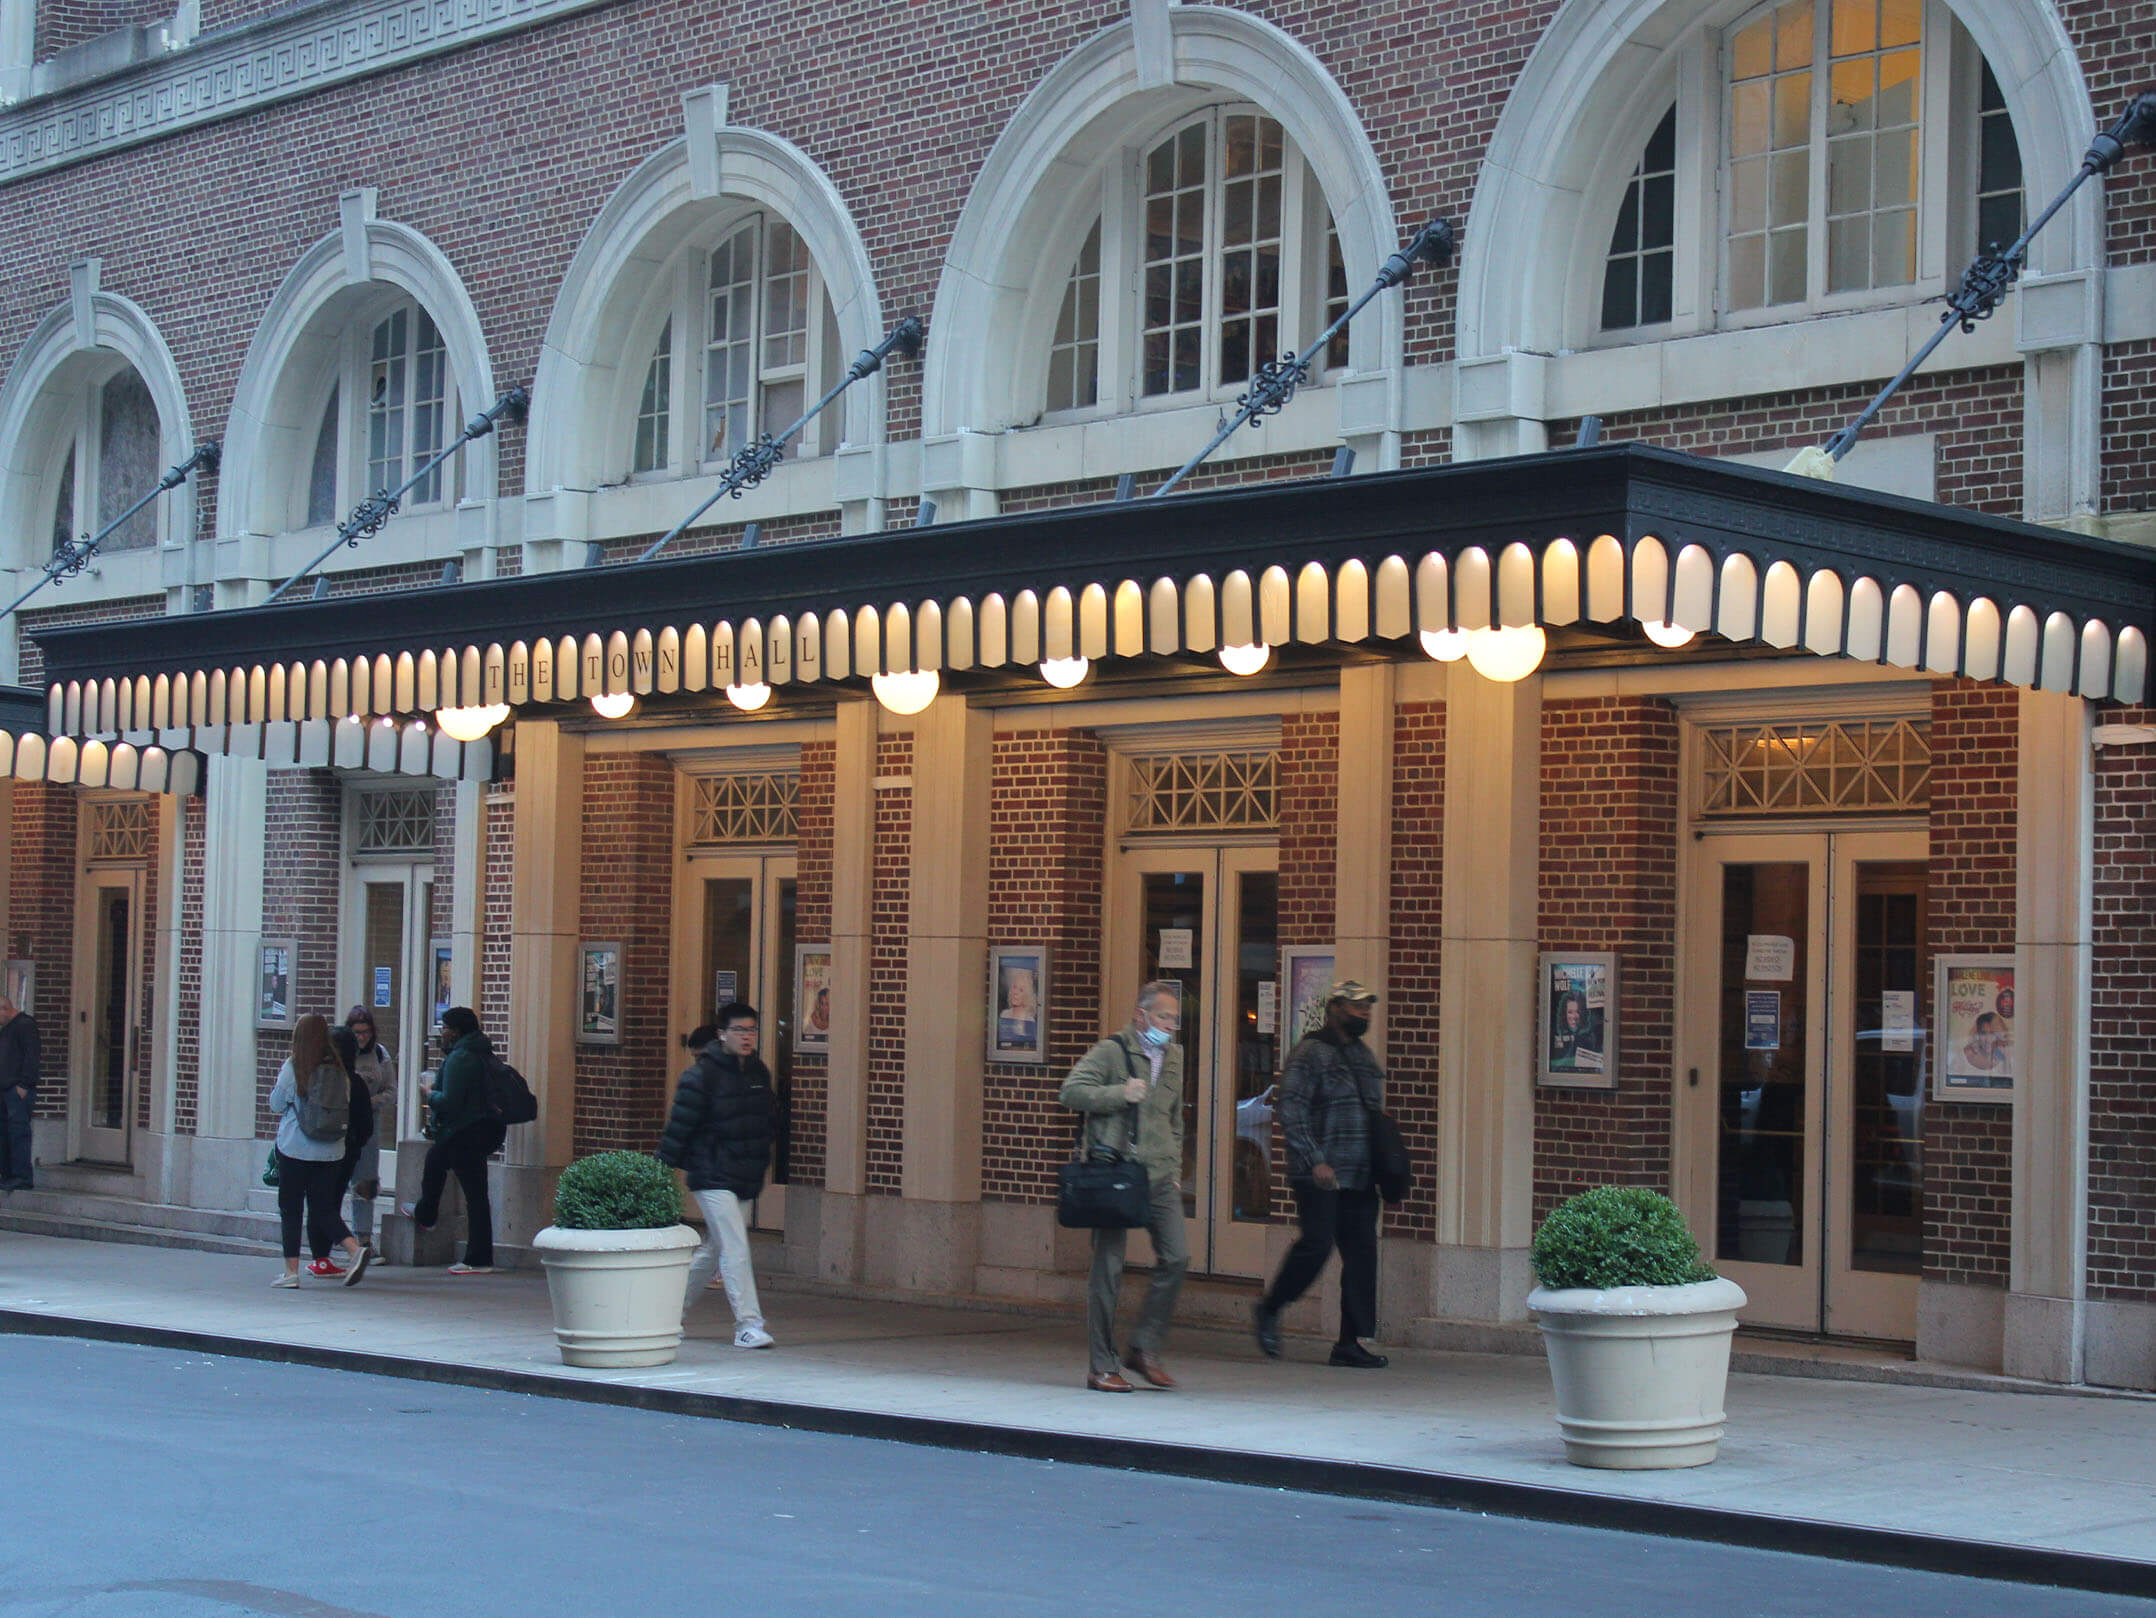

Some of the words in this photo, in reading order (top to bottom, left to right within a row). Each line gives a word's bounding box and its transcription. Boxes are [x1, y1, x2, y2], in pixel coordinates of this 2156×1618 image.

[488, 661, 548, 688] THE
[587, 649, 676, 680] TOWN
[716, 637, 815, 669] HALL
[1951, 982, 1985, 997] LOVE
